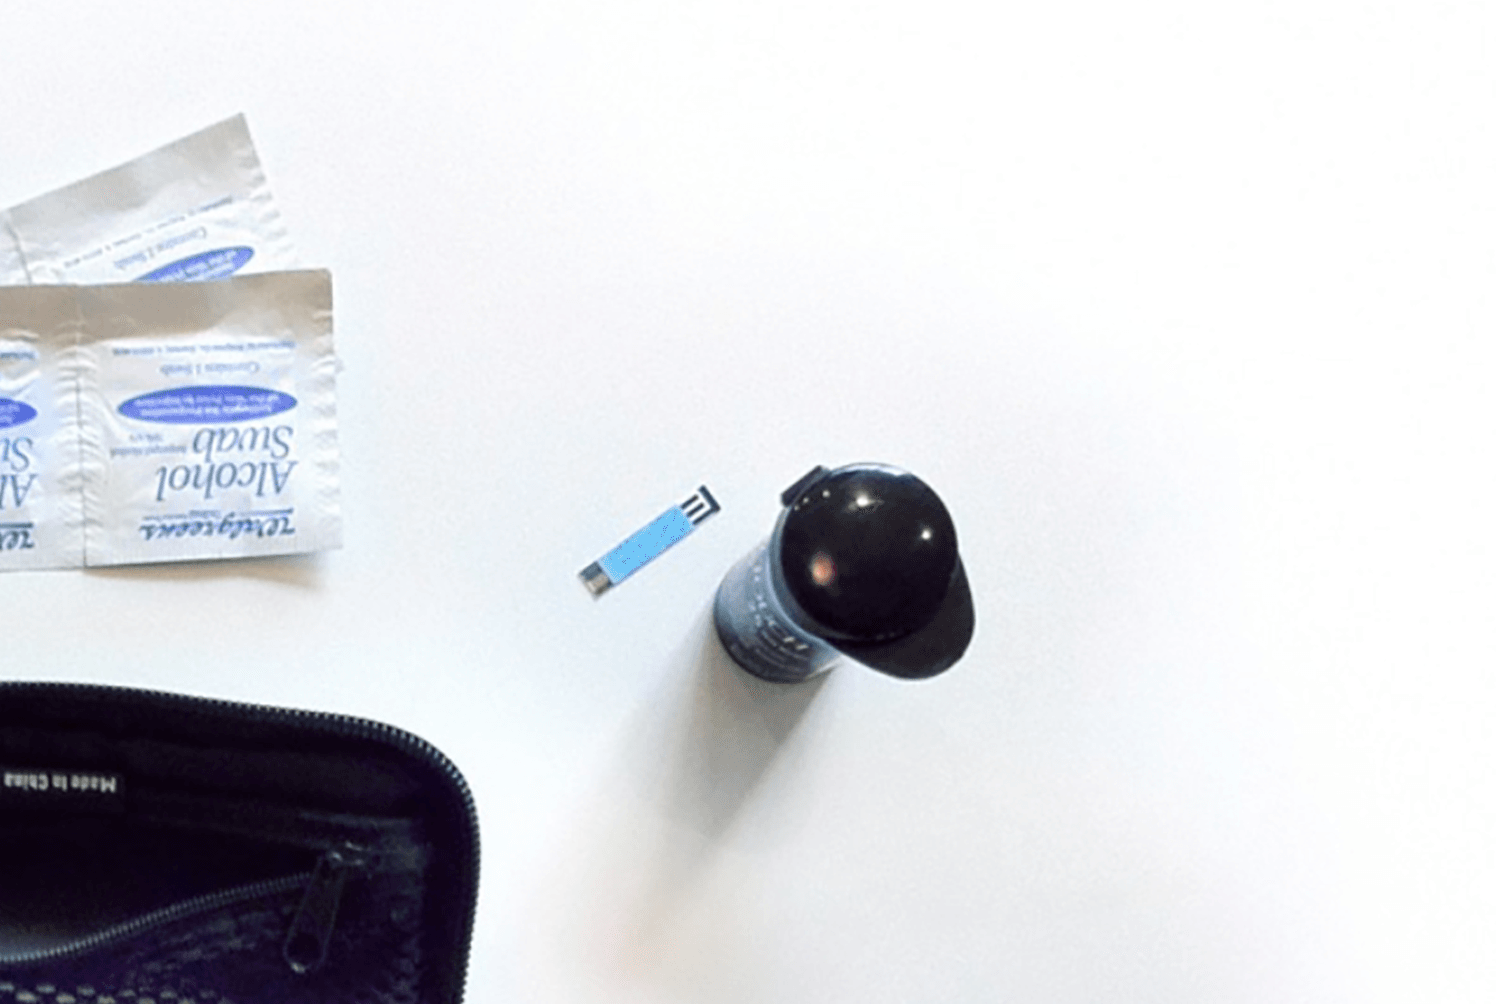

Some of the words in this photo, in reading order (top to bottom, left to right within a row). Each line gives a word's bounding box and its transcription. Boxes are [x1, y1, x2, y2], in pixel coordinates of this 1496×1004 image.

[191, 424, 294, 464] Swab
[154, 459, 299, 502] Alcohol
[137, 507, 295, 544] Walgreens
[3, 771, 49, 791] China
[70, 775, 116, 793] Made
